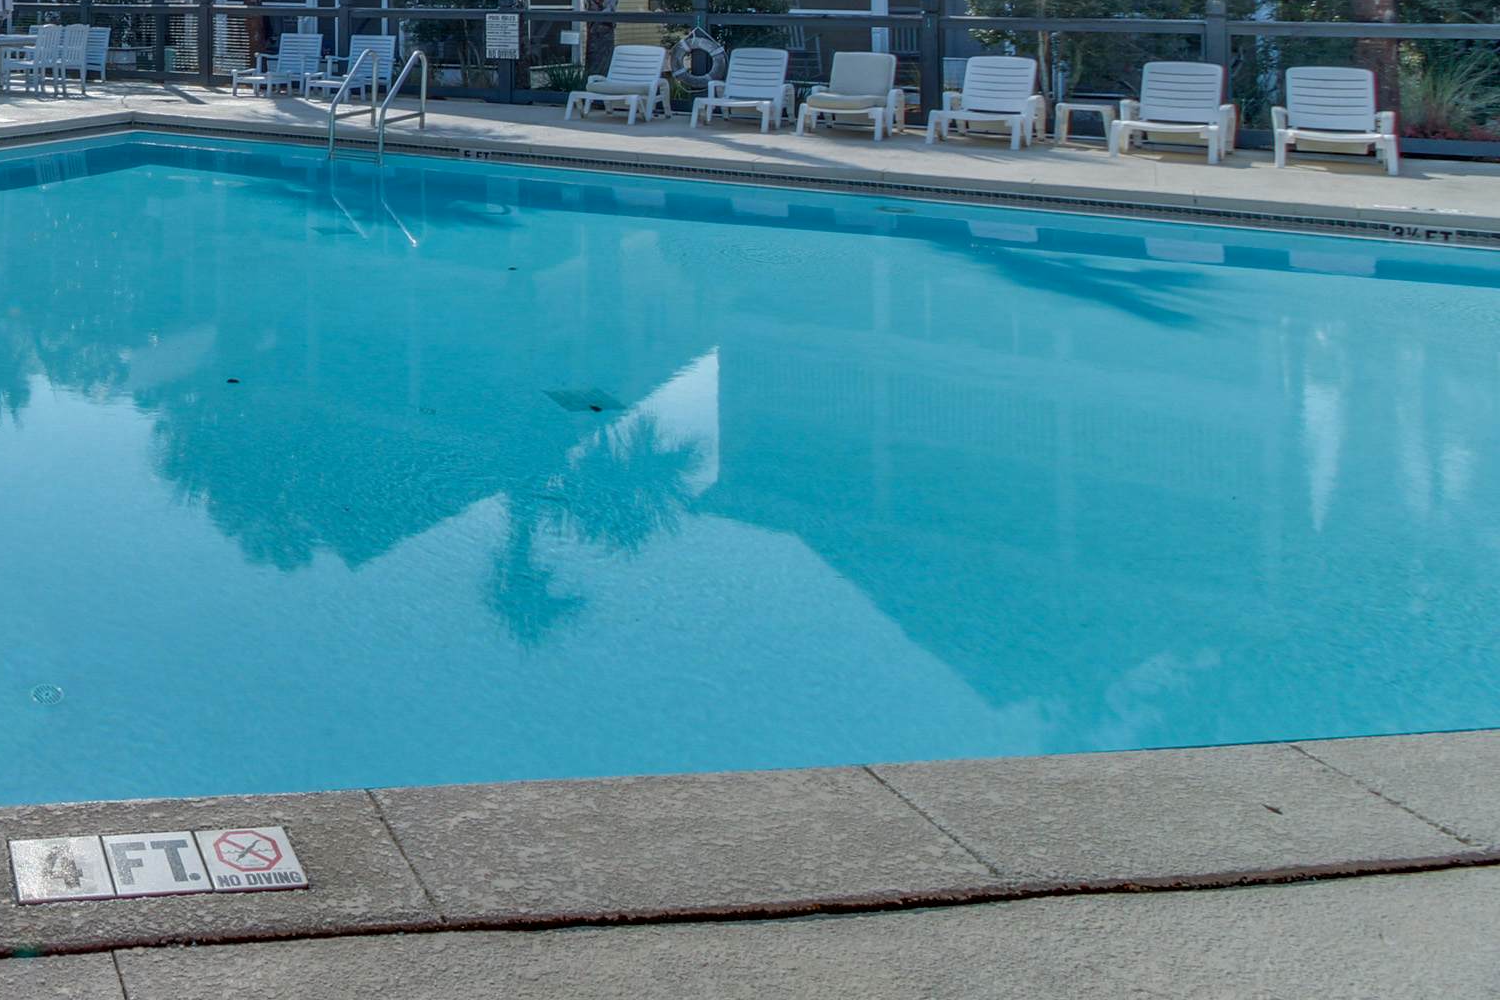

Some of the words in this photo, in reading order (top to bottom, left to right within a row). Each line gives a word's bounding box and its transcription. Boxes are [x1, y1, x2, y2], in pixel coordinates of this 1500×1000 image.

[43, 847, 83, 888] 4
[110, 839, 201, 885] FT.
[218, 874, 241, 887] NO
[250, 871, 302, 885] DIVING
